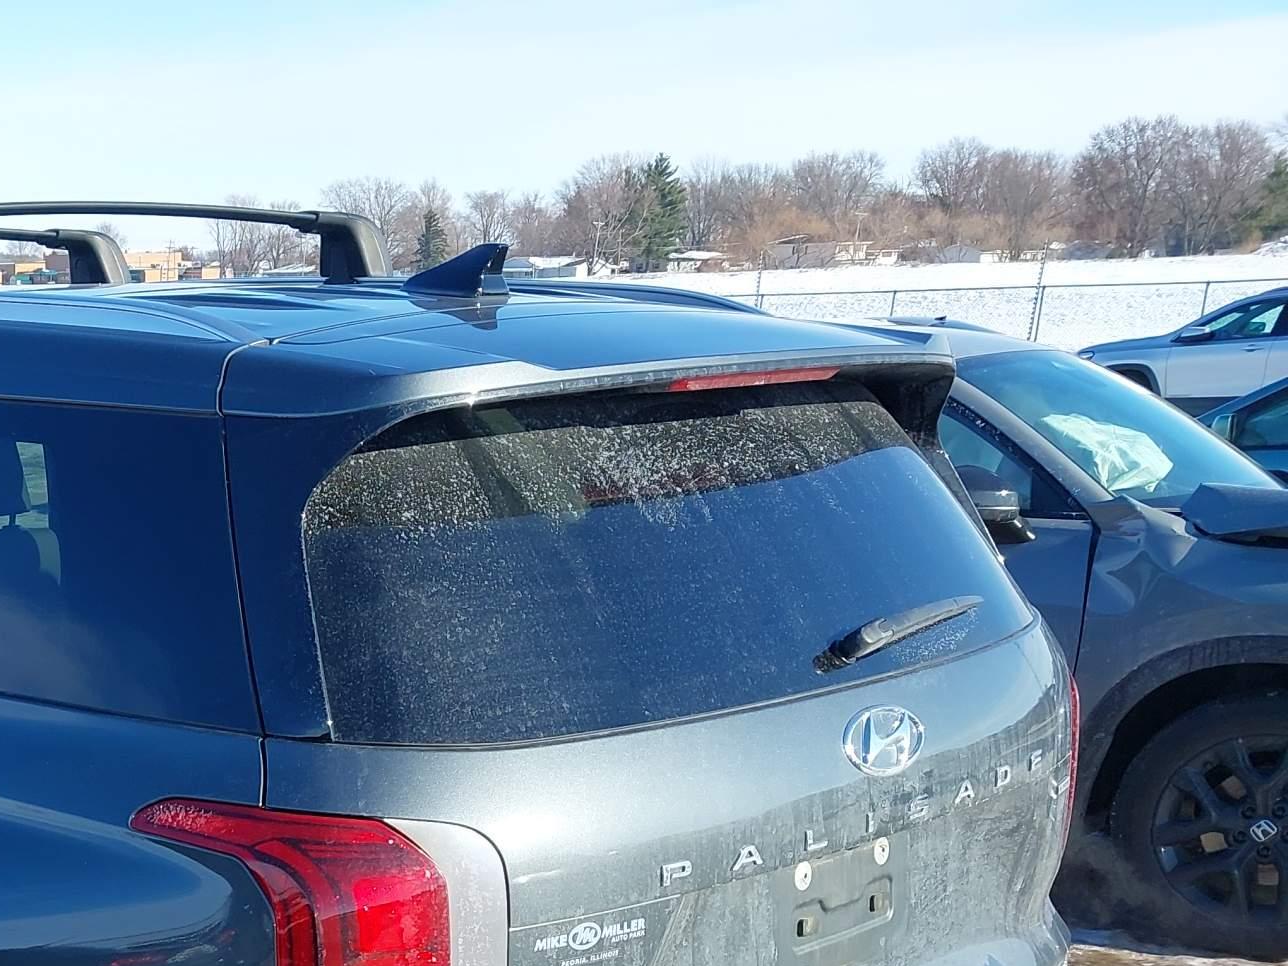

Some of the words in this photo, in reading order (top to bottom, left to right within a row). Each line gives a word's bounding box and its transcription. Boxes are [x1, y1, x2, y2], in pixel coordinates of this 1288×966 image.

[659, 748, 1043, 887] PALISADE
[534, 934, 568, 952] MIKE
[600, 917, 647, 939] MILLER
[611, 932, 629, 943] AUTO
[629, 929, 646, 940] PARK
